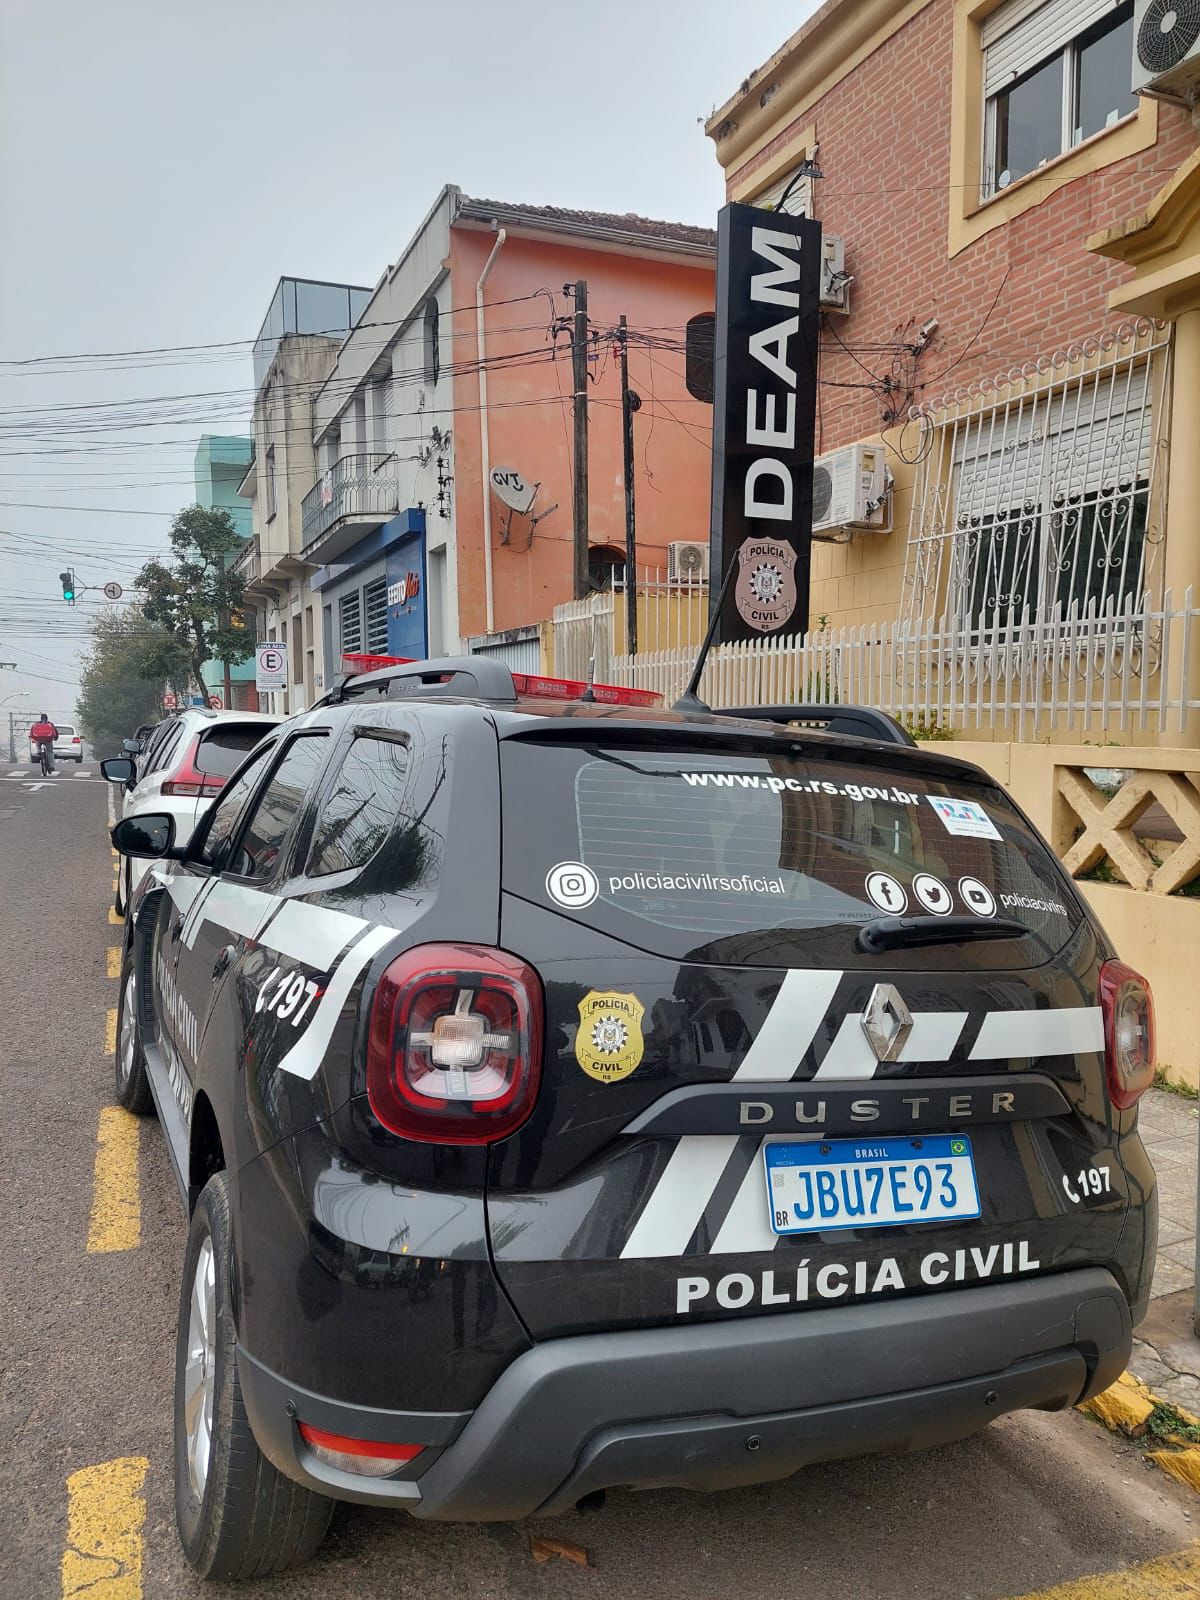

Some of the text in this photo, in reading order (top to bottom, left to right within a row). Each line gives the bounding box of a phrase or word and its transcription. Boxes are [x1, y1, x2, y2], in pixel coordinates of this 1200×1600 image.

[744, 226, 802, 521] DEAM
[493, 472, 519, 486] GVT
[750, 546, 784, 559] POLÍCIA
[751, 610, 780, 620] CIVIL
[266, 654, 277, 668] E
[681, 772, 921, 805] www.pc.rs.gov.br
[608, 872, 786, 894] policiacivilrsoficial
[1000, 893, 1068, 916] policiacivilrs
[267, 970, 319, 1027] 197
[592, 1000, 630, 1012] POLÍCIA
[178, 993, 198, 1064] CIVIL
[592, 1061, 623, 1071] CIVIL
[739, 1092, 1016, 1125] DUSTER
[855, 1147, 889, 1159] BRASIL
[793, 1163, 957, 1220] JBU7E93
[1077, 1166, 1111, 1197] 197
[775, 1210, 789, 1227] BR
[676, 1240, 1041, 1314] POLÍCIA CIVIL
